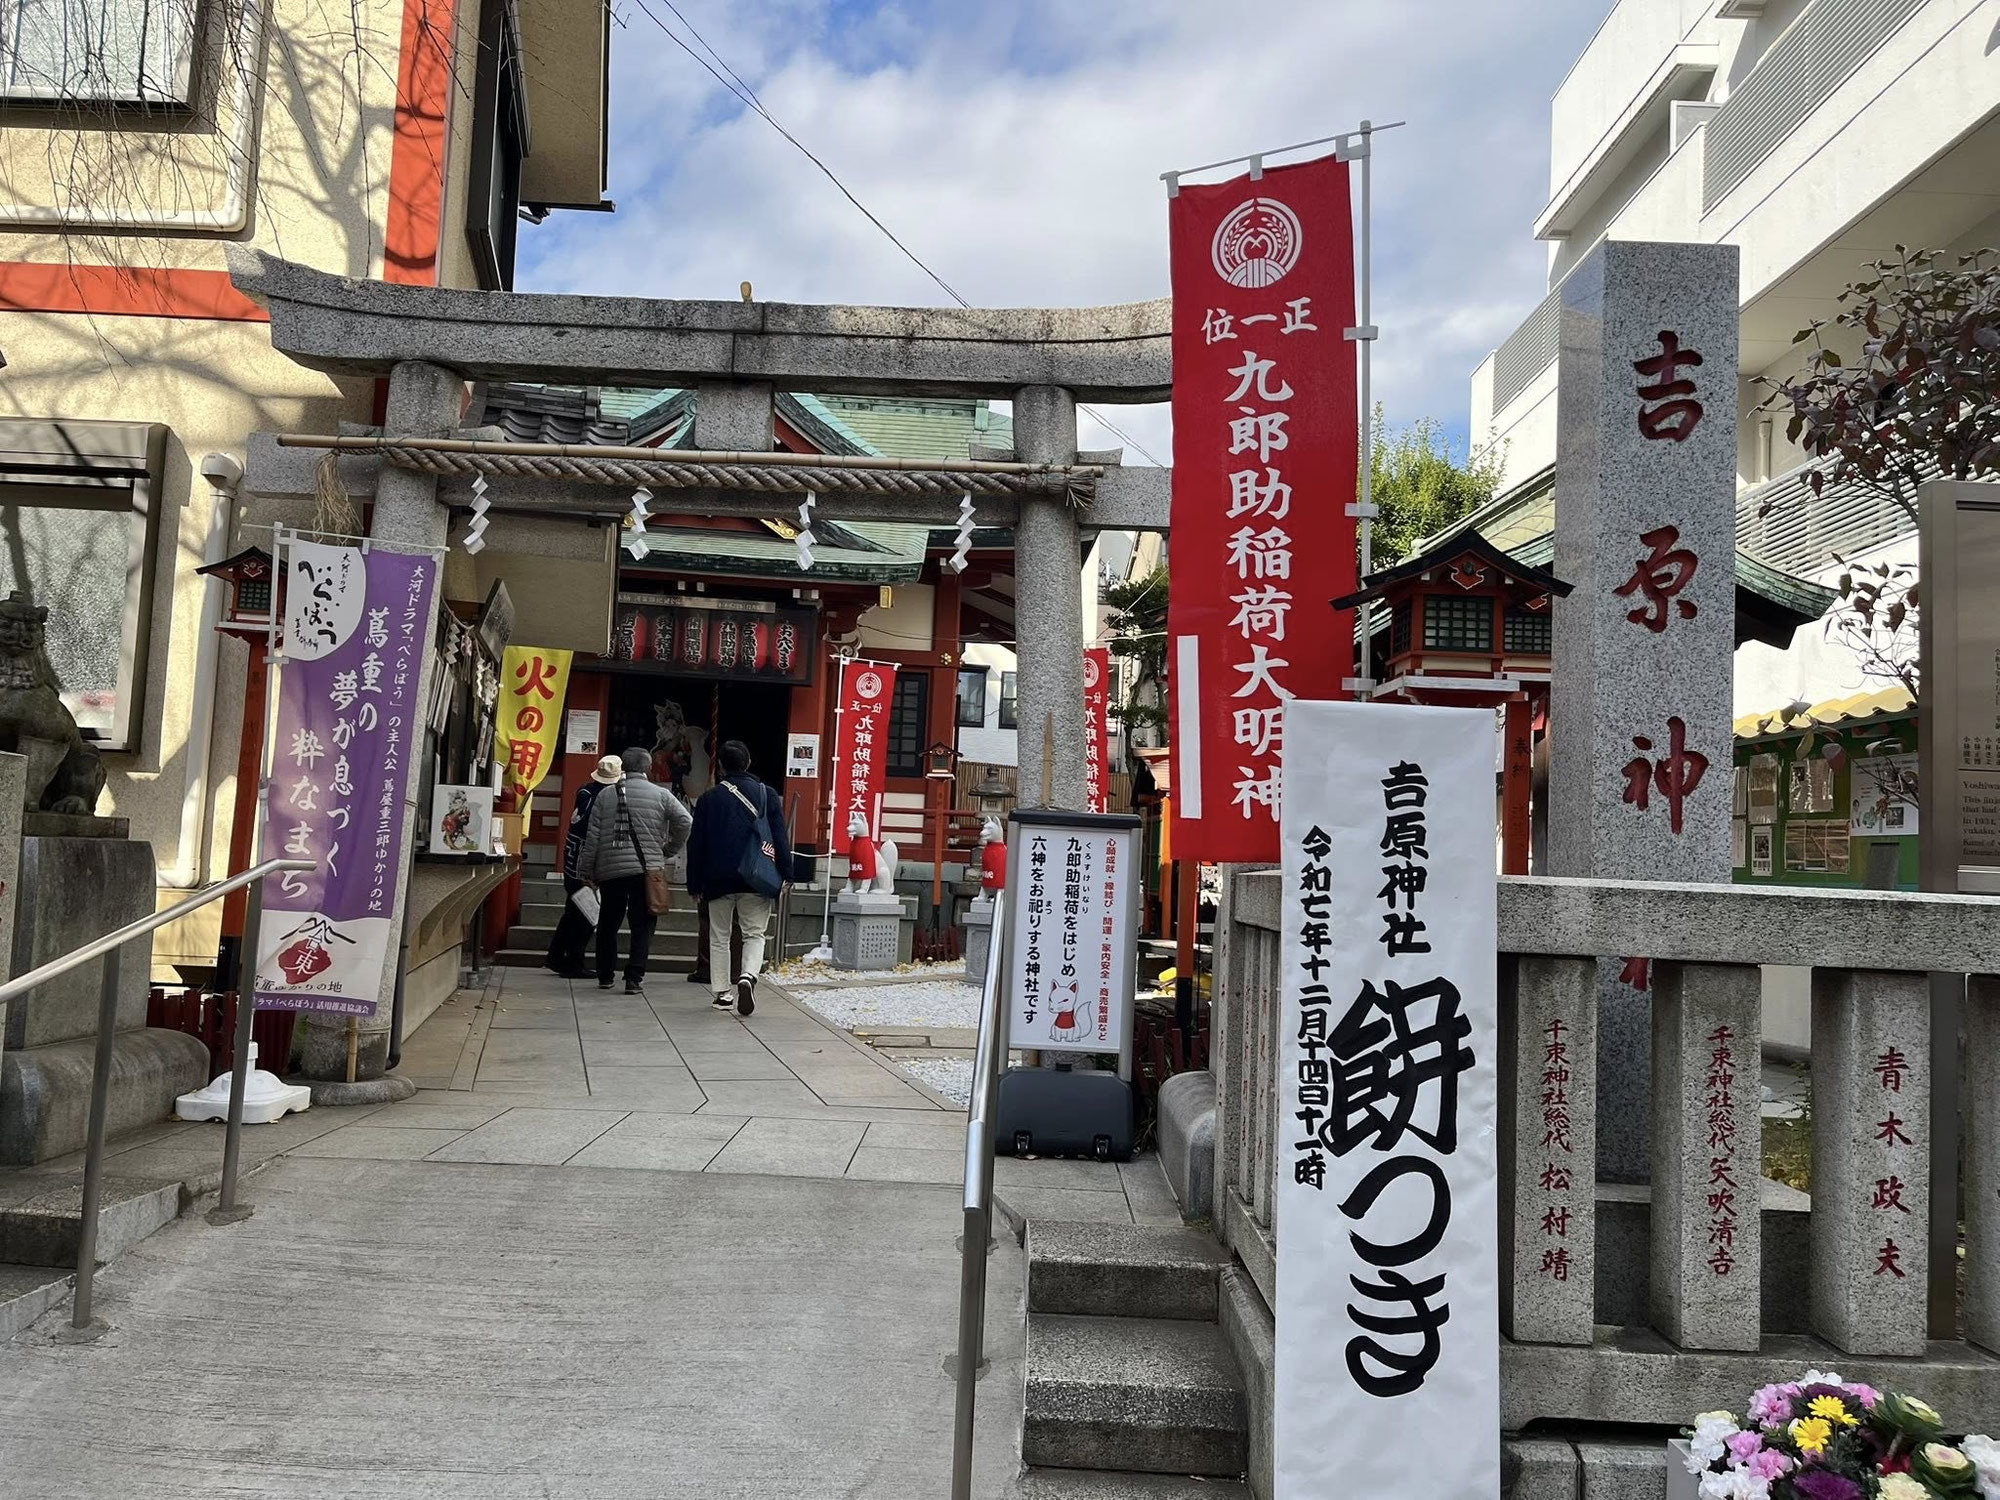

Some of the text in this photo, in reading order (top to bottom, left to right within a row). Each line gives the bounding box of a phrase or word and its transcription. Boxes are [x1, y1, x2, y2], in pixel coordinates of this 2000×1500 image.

[297, 560, 340, 646] べらぼう
[358, 606, 390, 731] 蔦重の
[776, 623, 795, 670] お穴さま
[1223, 350, 1296, 823] 九郎助稲荷大明神
[326, 668, 358, 878] 夢が息づく
[503, 656, 558, 796] 火の用
[280, 727, 326, 900] 粋なまち
[1081, 841, 1092, 914] くろすけいなり
[1377, 759, 1431, 958] 吉原神社
[1023, 835, 1048, 1024] 六神をお祀りする神社です
[1060, 836, 1082, 977] 九郎助稲荷をはじめ
[1294, 825, 1332, 1191] 令和七年十二月十四日十一時
[1318, 976, 1476, 1398] 餅つき
[1539, 1163, 1574, 1282] 松村靖
[1870, 1046, 1912, 1280] 青木政夫
